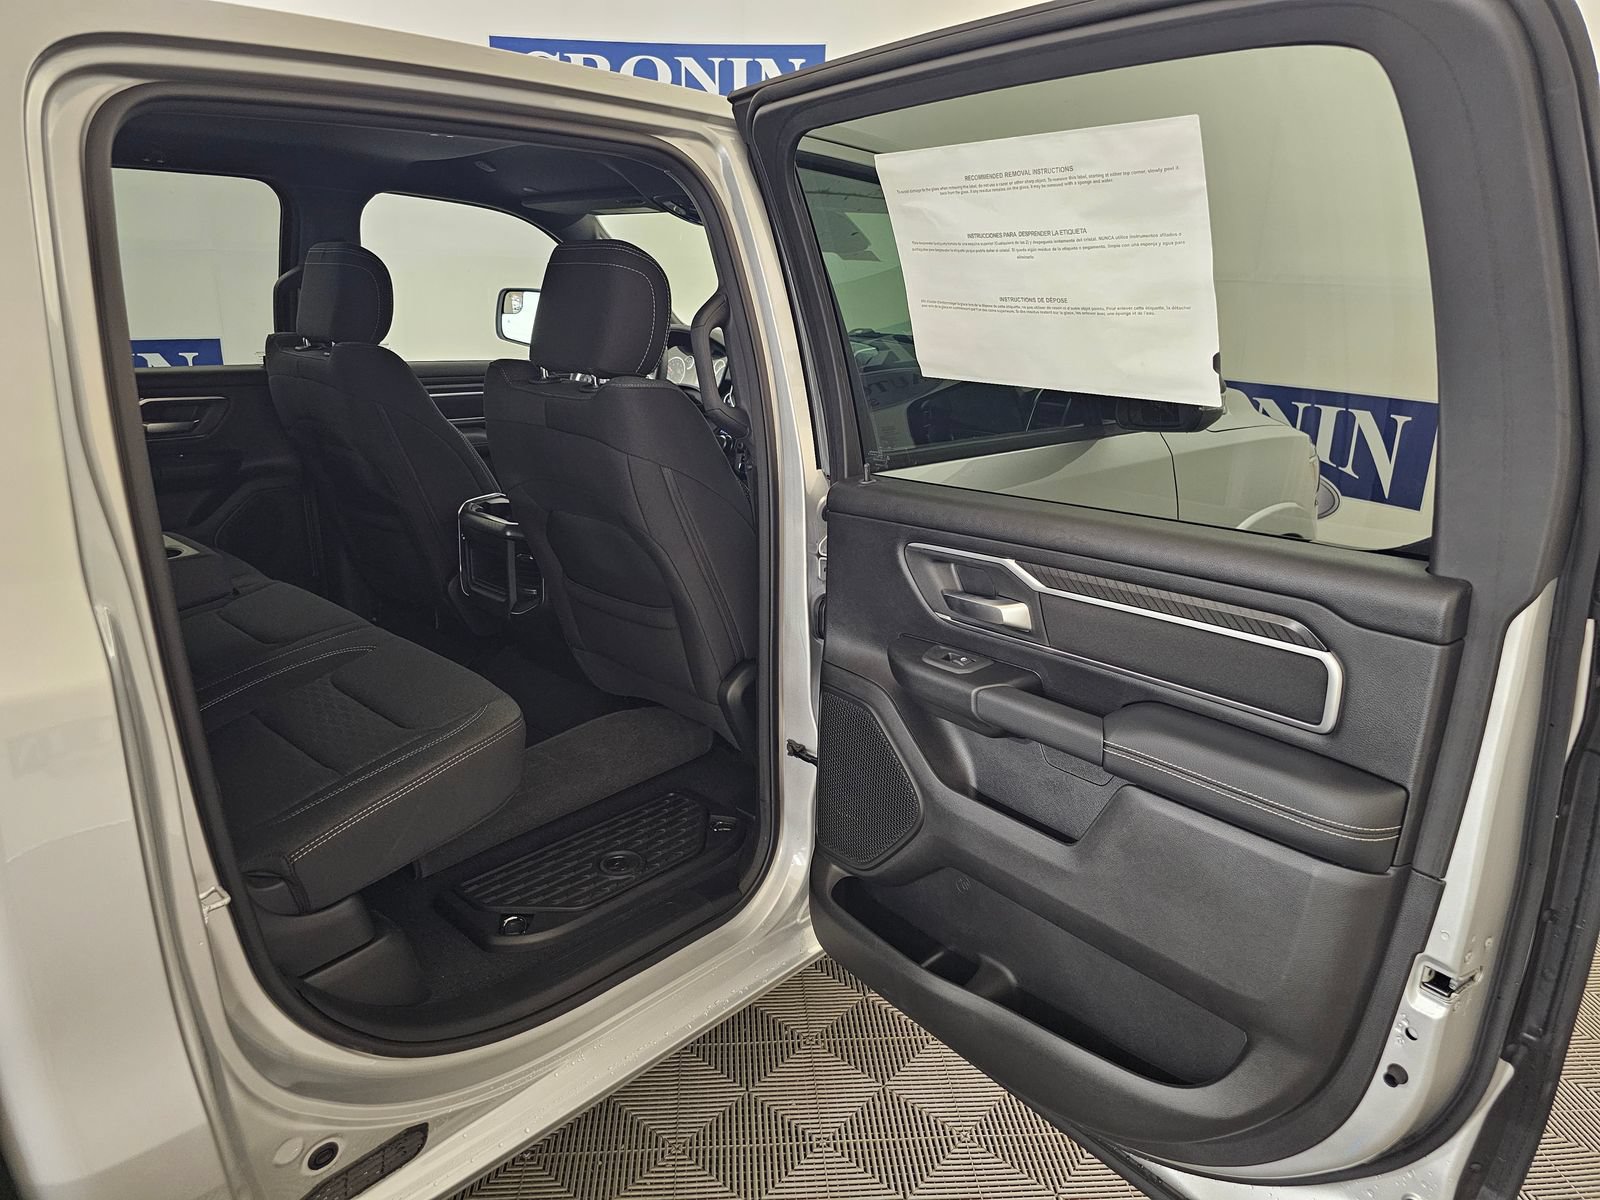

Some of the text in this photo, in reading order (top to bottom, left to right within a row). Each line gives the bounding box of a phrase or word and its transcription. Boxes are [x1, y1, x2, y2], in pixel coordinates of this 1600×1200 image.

[522, 50, 807, 95] ONI
[964, 165, 1074, 182] RECOMMENDED REMOVAL INSTRUCTIONS
[1018, 230, 1051, 238] DESPRENDER
[1051, 229, 1059, 237] LA
[1059, 227, 1088, 236] ETIQUETA
